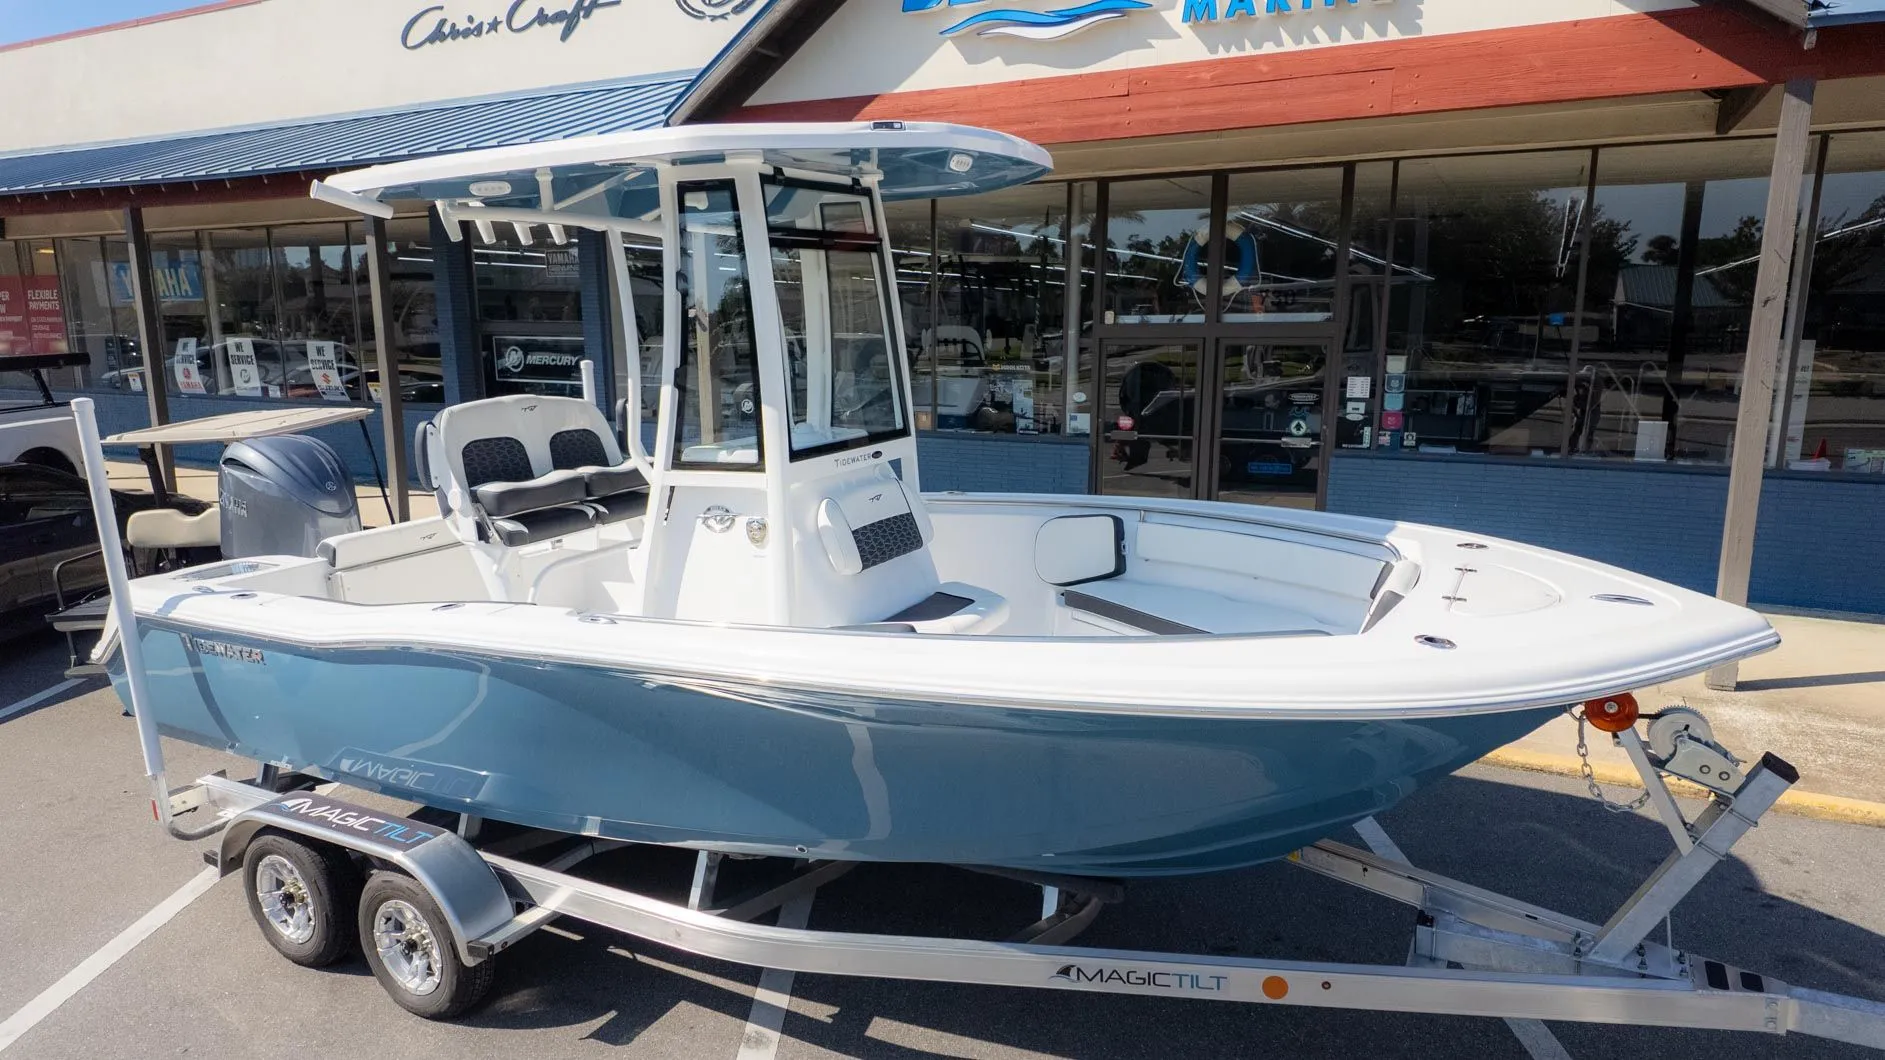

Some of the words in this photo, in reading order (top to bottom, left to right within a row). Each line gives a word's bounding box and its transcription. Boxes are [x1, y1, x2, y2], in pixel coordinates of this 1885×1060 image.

[401, 5, 484, 50] Chris
[119, 265, 193, 297] YAHA
[27, 289, 59, 300] FLEXIBLE
[28, 301, 60, 311] PAYMENTS
[234, 341, 245, 353] WE
[315, 345, 326, 357] WE
[230, 354, 255, 366] SERVICE
[310, 359, 336, 371] SERVICE
[525, 355, 579, 366] MERCURY
[833, 452, 871, 468] TIDEWATER
